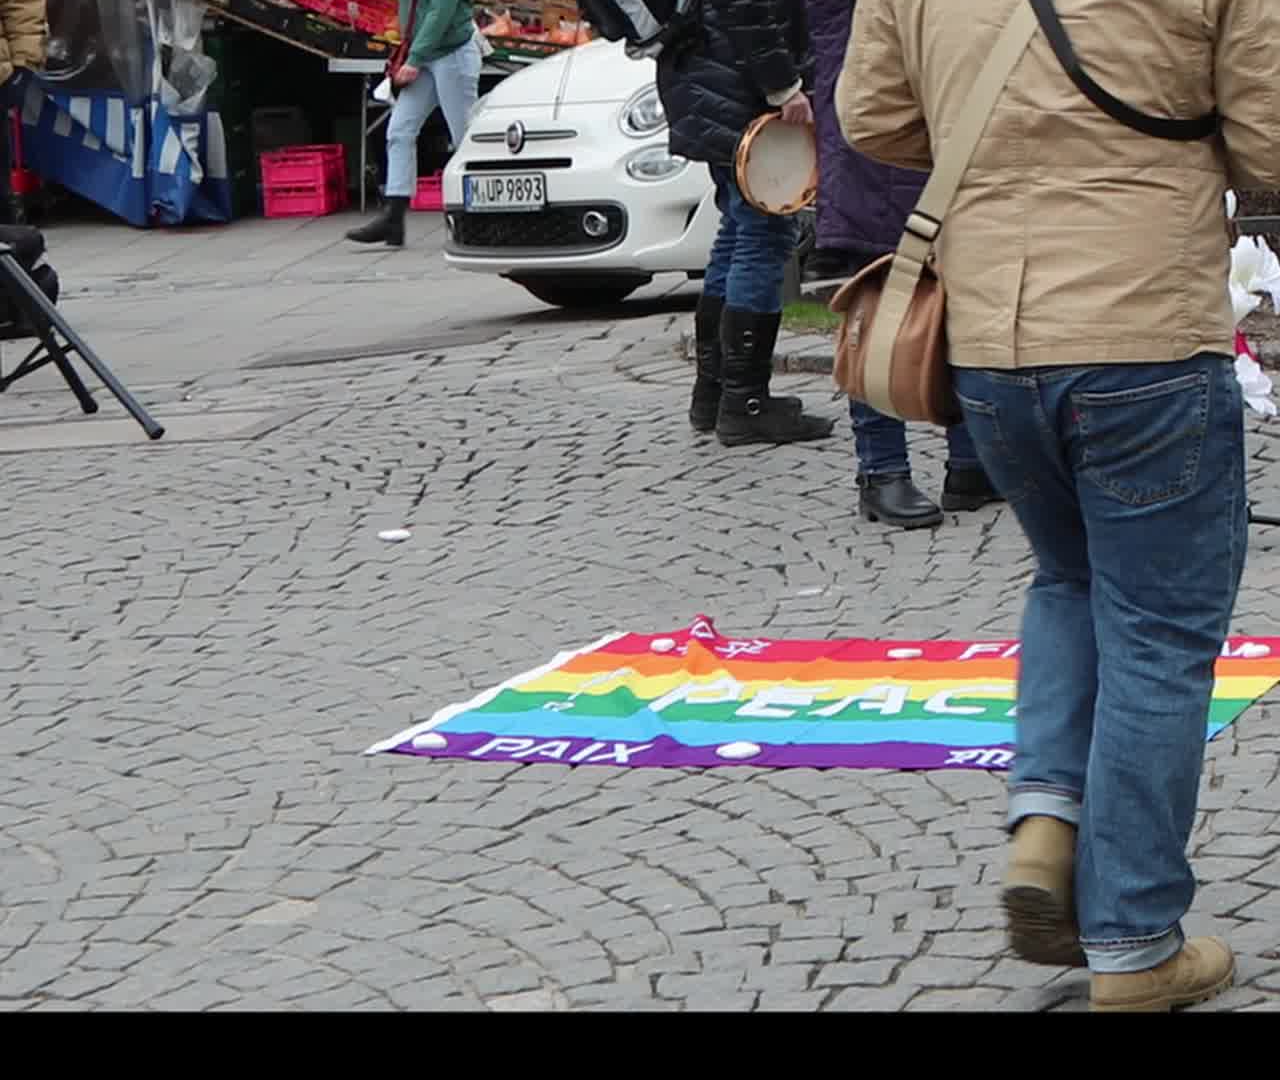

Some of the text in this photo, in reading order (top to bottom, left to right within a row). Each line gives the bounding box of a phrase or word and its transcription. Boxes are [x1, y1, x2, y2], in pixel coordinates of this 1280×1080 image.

[507, 177, 542, 201] 9893
[648, 676, 1018, 718] PEAC
[469, 737, 655, 763] PAIX
